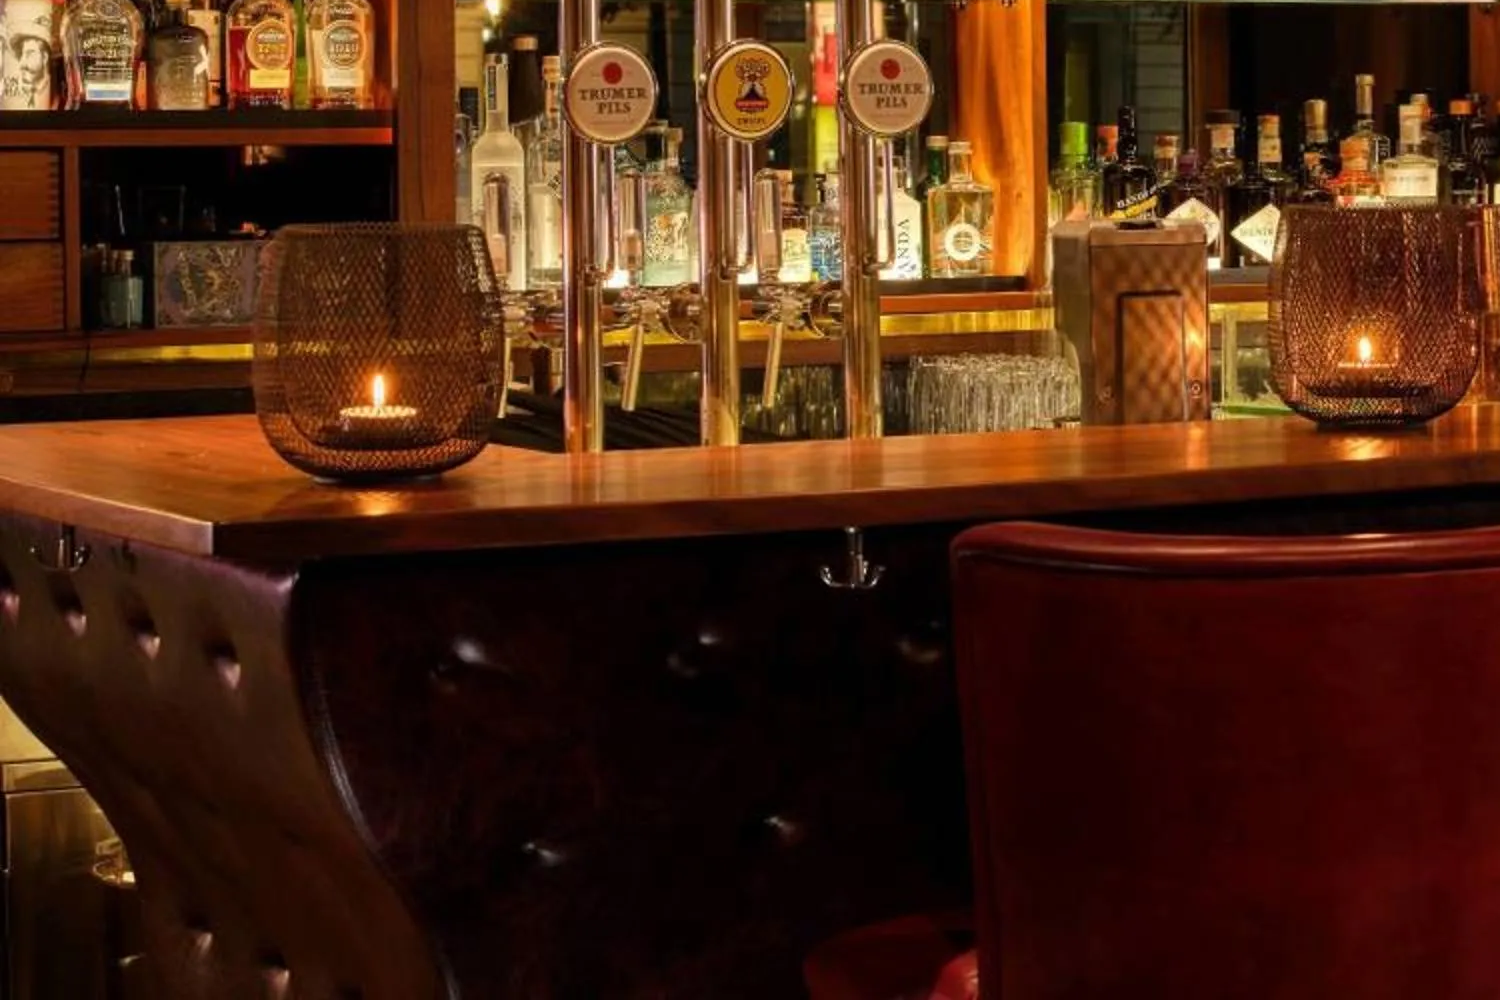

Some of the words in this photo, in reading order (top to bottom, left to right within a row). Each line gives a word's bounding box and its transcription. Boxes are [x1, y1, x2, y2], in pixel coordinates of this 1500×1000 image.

[577, 87, 648, 101] TRUMER
[858, 83, 925, 95] TRUMER
[596, 101, 632, 115] PILS
[876, 96, 908, 109] PILS
